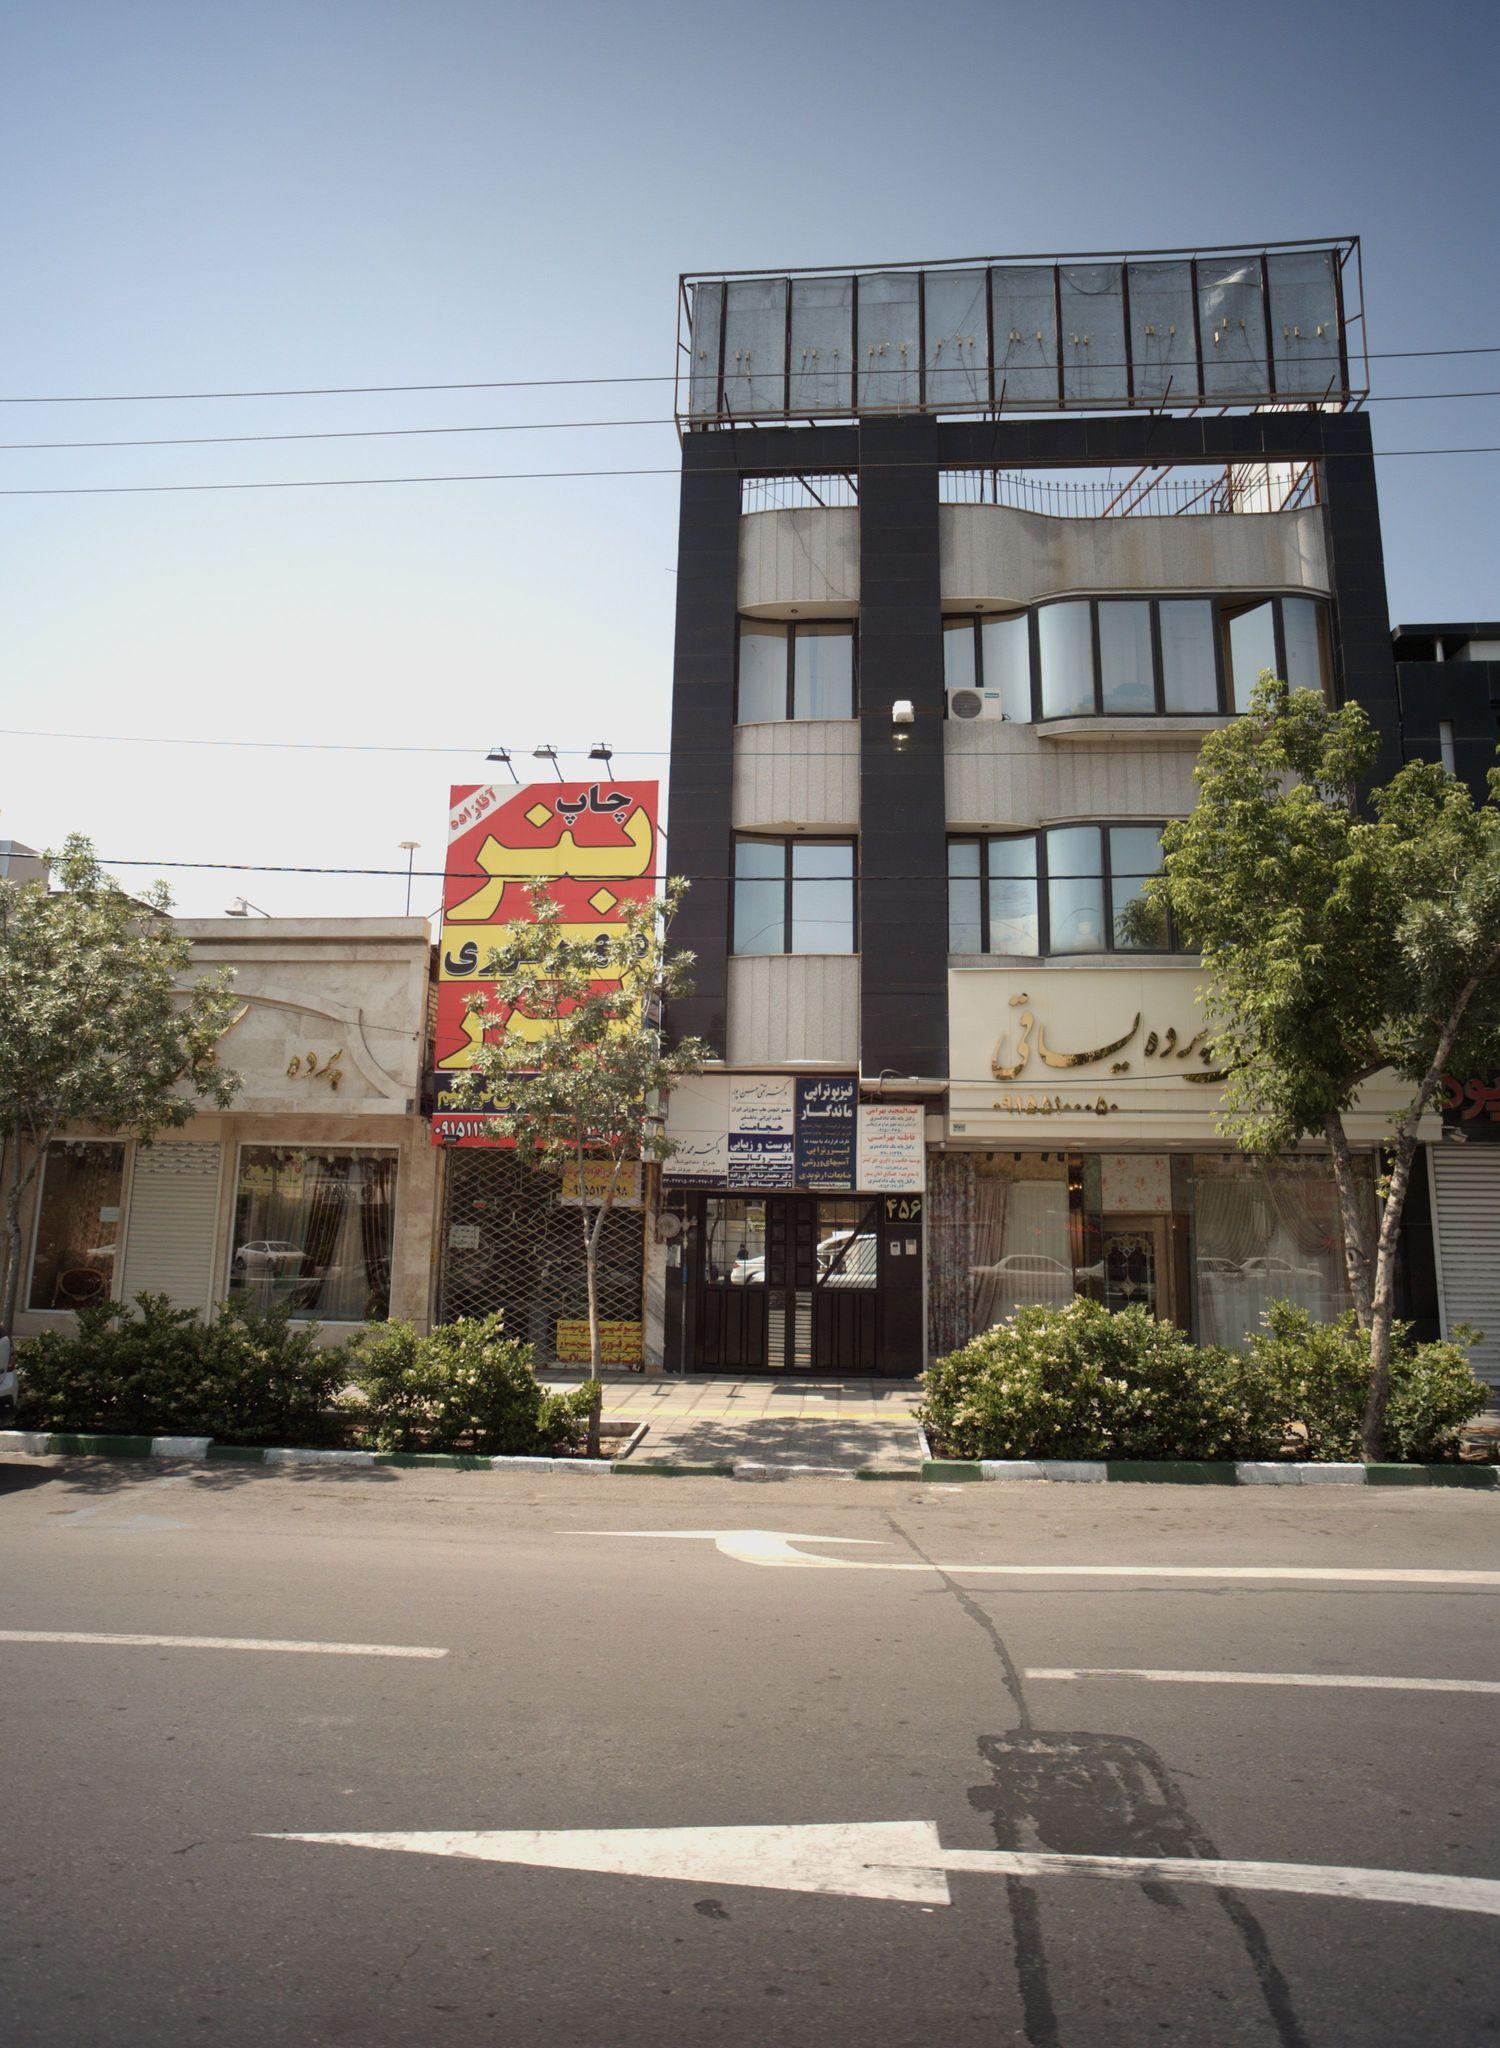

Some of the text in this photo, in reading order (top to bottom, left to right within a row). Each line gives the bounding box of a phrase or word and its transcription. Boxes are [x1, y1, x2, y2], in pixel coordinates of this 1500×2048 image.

[450, 786, 498, 833] آقازاده
[556, 784, 632, 826] چاپ
[444, 804, 654, 921] بنر
[286, 1048, 344, 1092] پرده
[766, 1079, 792, 1096] دکتر
[803, 1081, 853, 1102] فیزیوتراپی
[801, 1103, 853, 1121] ماندگار
[993, 1096, 1118, 1116] ۰۹۱۵۵۱۰۰۰۵۰
[739, 1122, 783, 1133] حجامت
[730, 1139, 792, 1152] پوست و زیبایی
[768, 1154, 792, 1163] دفتر
[886, 1199, 922, 1219] ۴۵۶
